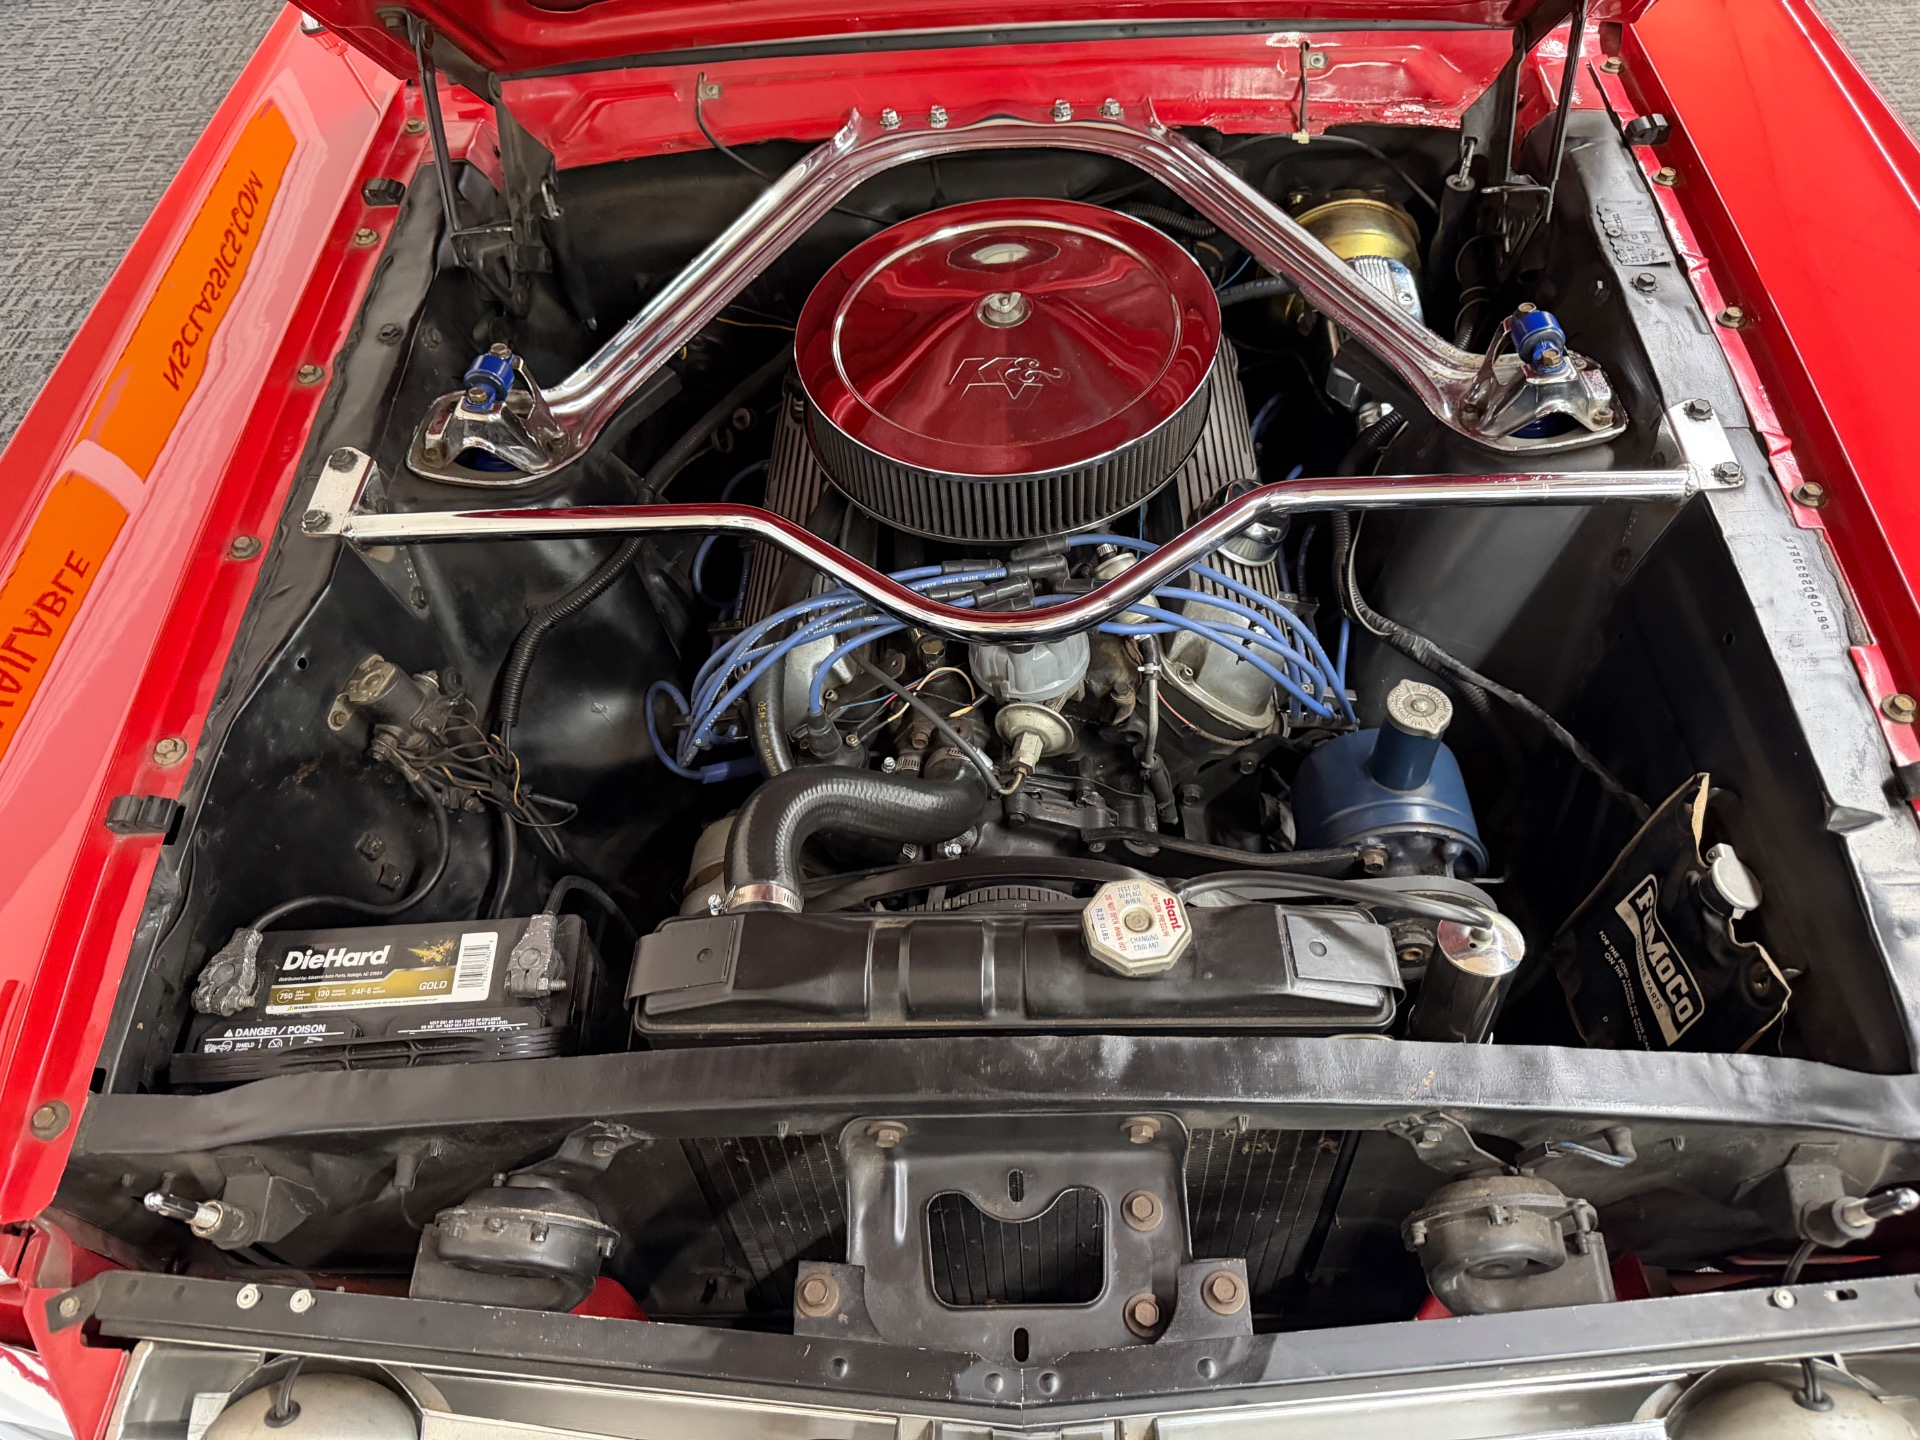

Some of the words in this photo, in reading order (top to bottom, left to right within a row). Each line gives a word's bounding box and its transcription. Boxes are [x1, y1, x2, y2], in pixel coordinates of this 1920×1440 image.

[1163, 897, 1182, 932] Stant
[282, 945, 391, 971] DieHard
[1598, 930, 1610, 947] FOR
[1608, 944, 1620, 960] THE
[1617, 958, 1630, 979] FORD
[1604, 952, 1615, 965] ON
[1613, 964, 1624, 978] THE
[280, 992, 293, 1000] 750
[317, 989, 330, 997] 130
[419, 980, 447, 991] GOLD
[1645, 980, 1663, 1010] PARTS
[235, 1026, 278, 1037] DANGER
[278, 1026, 286, 1035] /
[287, 1024, 326, 1034] POISON
